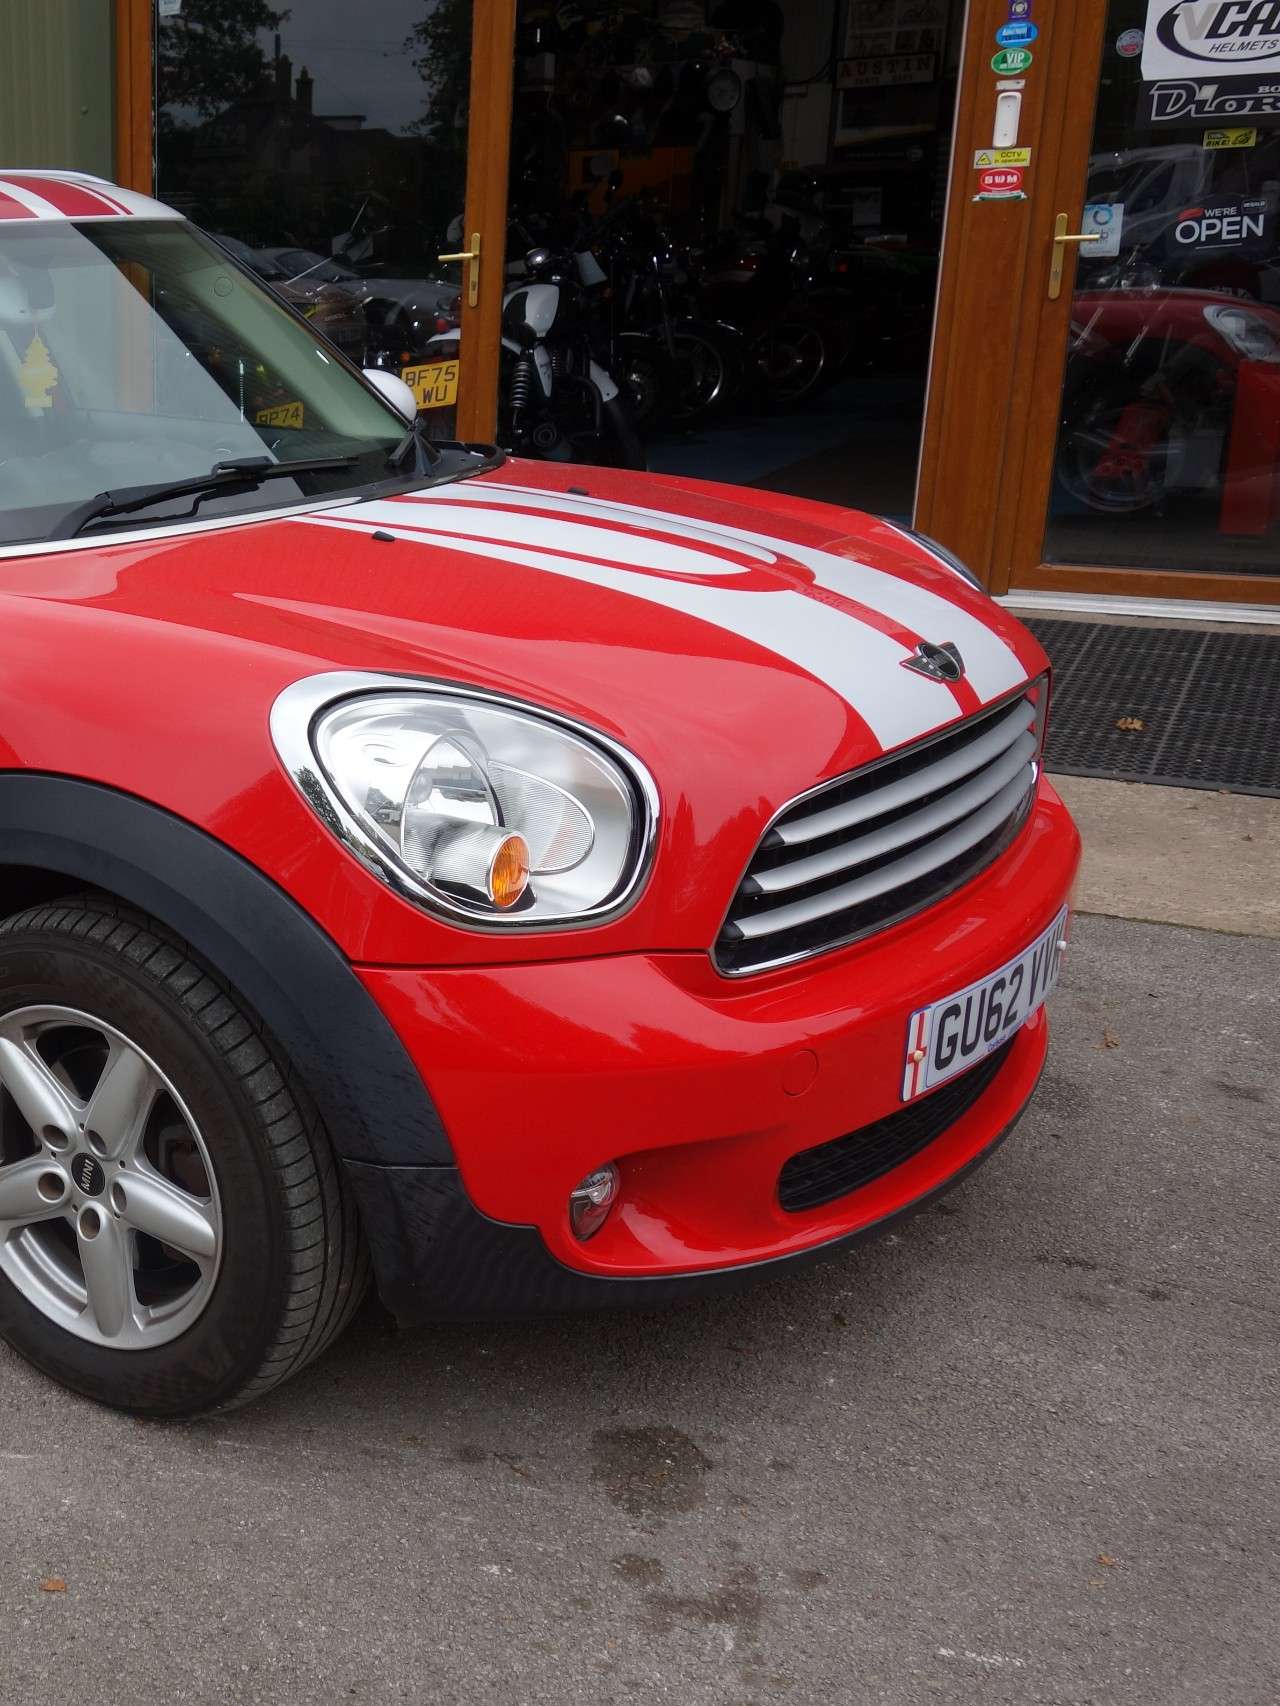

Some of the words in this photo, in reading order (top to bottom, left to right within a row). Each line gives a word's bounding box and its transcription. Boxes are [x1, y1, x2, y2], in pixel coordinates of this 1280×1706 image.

[1208, 38, 1280, 55] HELMETS
[841, 56, 931, 77] AUSTIN
[1204, 207, 1238, 218] WE'RE
[1175, 214, 1265, 244] OPEN
[405, 364, 457, 388] BF75
[416, 385, 448, 405] WU
[934, 963, 1024, 1071] GU62
[80, 1158, 95, 1191] MINI
